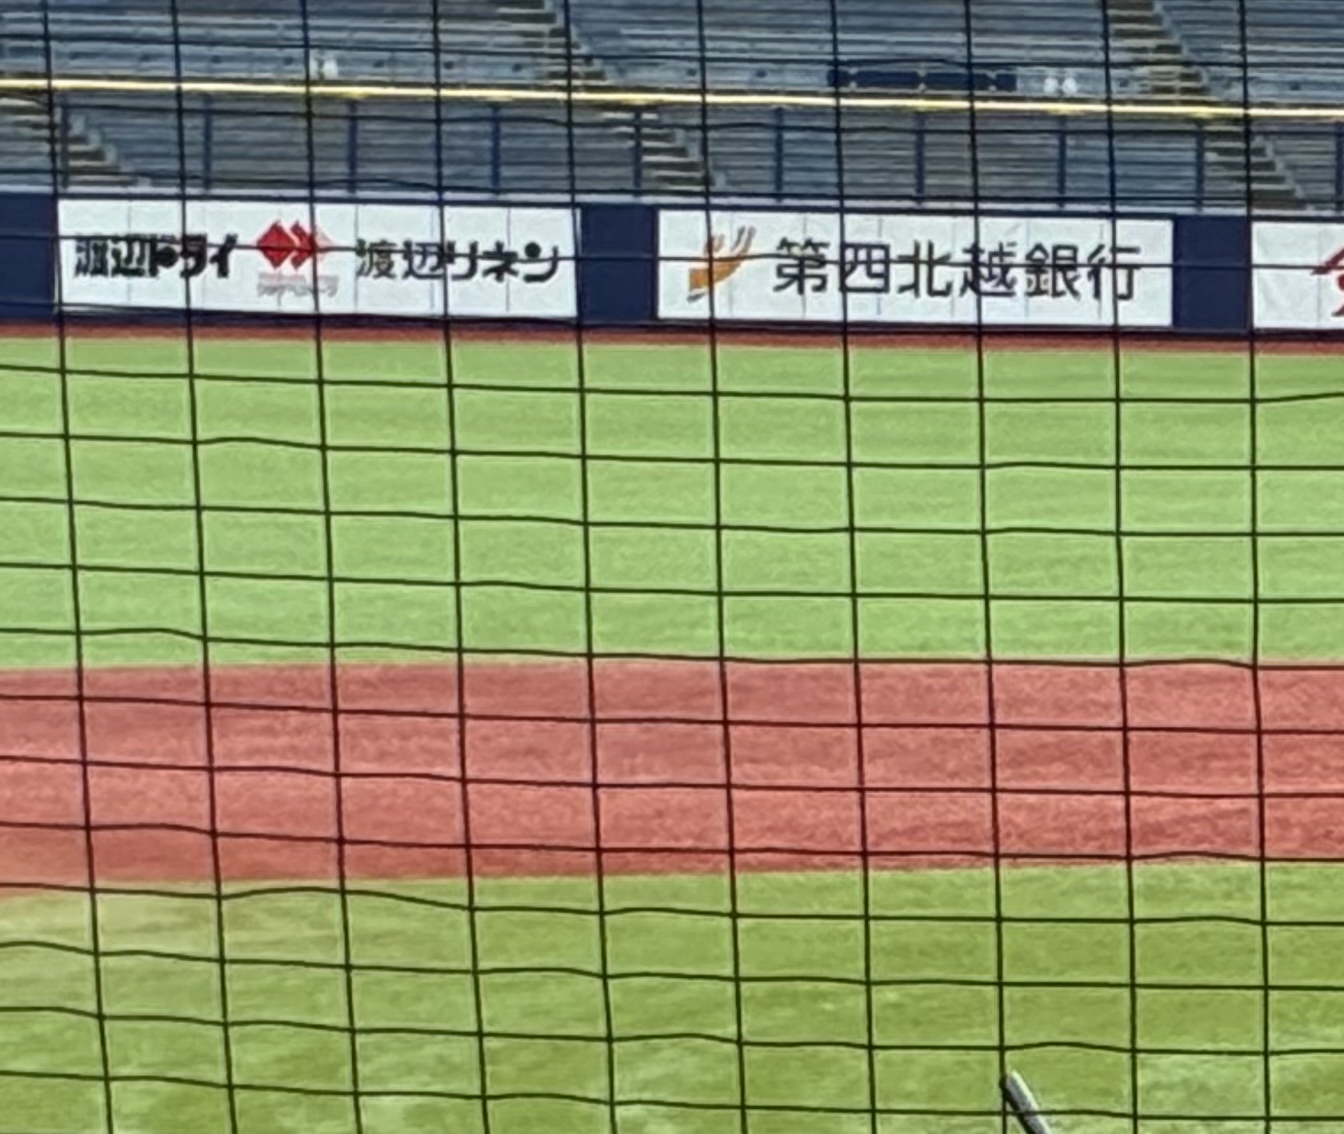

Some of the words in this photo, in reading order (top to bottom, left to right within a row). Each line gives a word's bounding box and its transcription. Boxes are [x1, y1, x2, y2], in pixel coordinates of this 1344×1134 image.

[356, 238, 559, 283] 渡辺リネン
[773, 237, 1141, 300] 第四北越銀行
